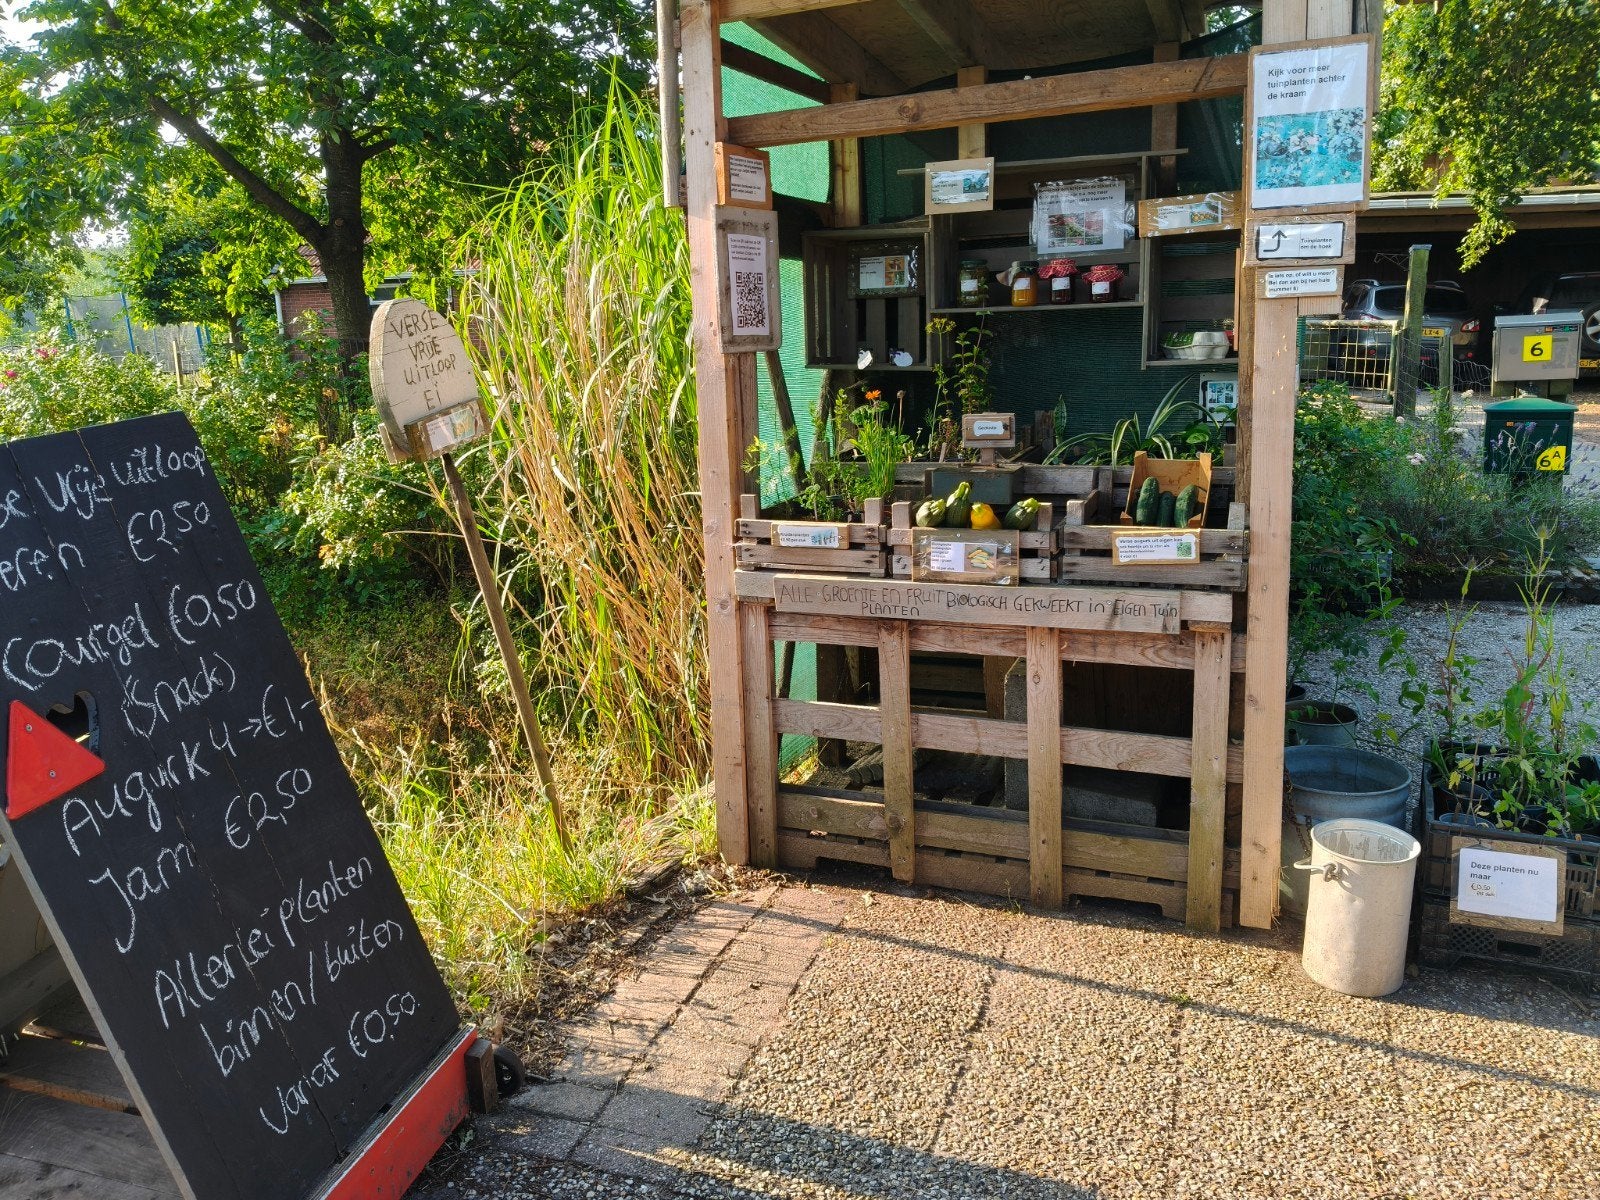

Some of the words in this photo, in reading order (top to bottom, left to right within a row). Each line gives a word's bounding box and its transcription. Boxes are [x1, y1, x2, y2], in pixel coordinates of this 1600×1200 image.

[1267, 78, 1316, 89] tuinplanten
[1318, 75, 1346, 84] achter
[1268, 68, 1285, 78] Kijk
[1287, 67, 1306, 75] voor
[1309, 64, 1330, 72] meer
[1267, 92, 1278, 100] de
[1280, 90, 1307, 99] kraam
[390, 309, 438, 339] VERSE
[1530, 341, 1544, 357] 6
[127, 500, 211, 562] €2,50
[168, 579, 256, 645] €0,50
[779, 584, 813, 604] ALLE
[1013, 594, 1084, 613] GEKWEEKT
[62, 741, 211, 857] Augurk
[209, 720, 237, 758] 4
[88, 842, 194, 954] Jam
[225, 768, 312, 849] €2,50
[1470, 861, 1492, 871] Deze
[1493, 864, 1526, 874] planten
[1470, 872, 1492, 880] maar
[279, 856, 373, 947] planten
